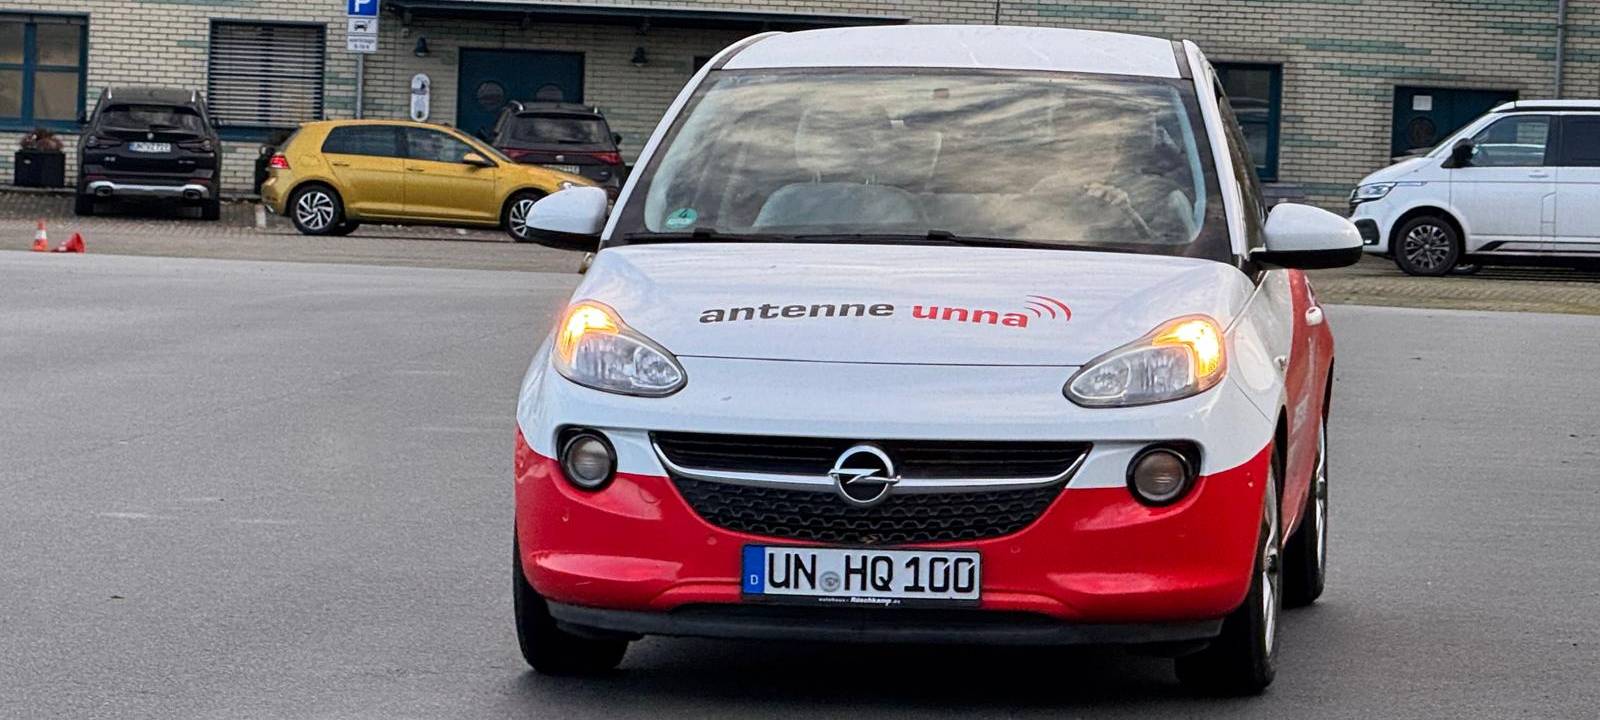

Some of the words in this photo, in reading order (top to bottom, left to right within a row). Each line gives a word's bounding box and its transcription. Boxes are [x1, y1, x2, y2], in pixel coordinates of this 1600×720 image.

[699, 302, 894, 325] antenne
[912, 304, 1028, 329] unna
[750, 574, 759, 584] D
[768, 553, 816, 591] UN
[844, 555, 894, 592] HQ
[904, 556, 976, 593] 100
